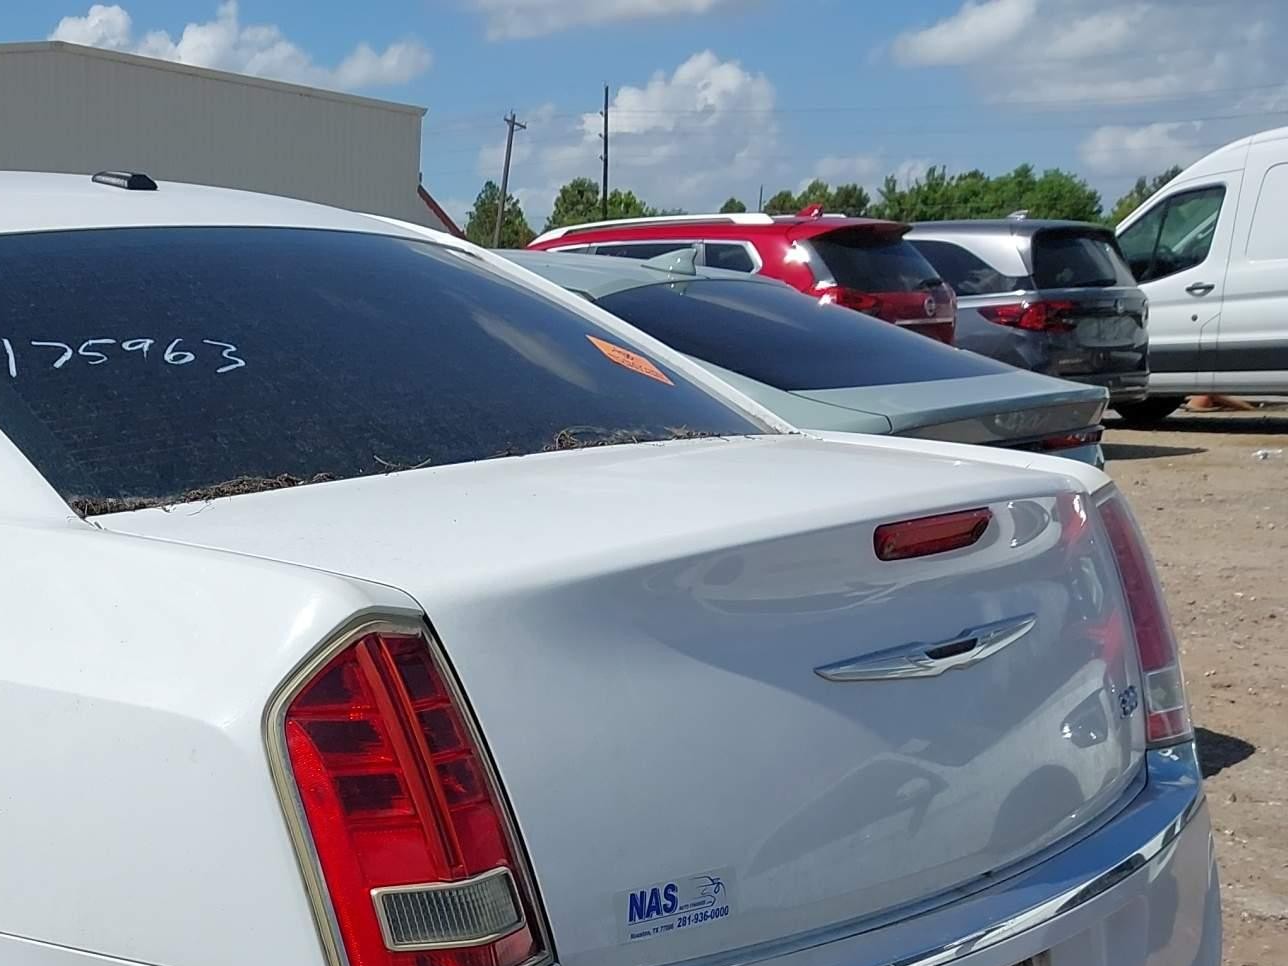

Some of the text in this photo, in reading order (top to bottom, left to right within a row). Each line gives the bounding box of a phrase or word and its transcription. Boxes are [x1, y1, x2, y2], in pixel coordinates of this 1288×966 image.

[1, 338, 247, 378] 175963
[628, 883, 678, 922] NAS
[677, 905, 729, 928] 281-936-0000
